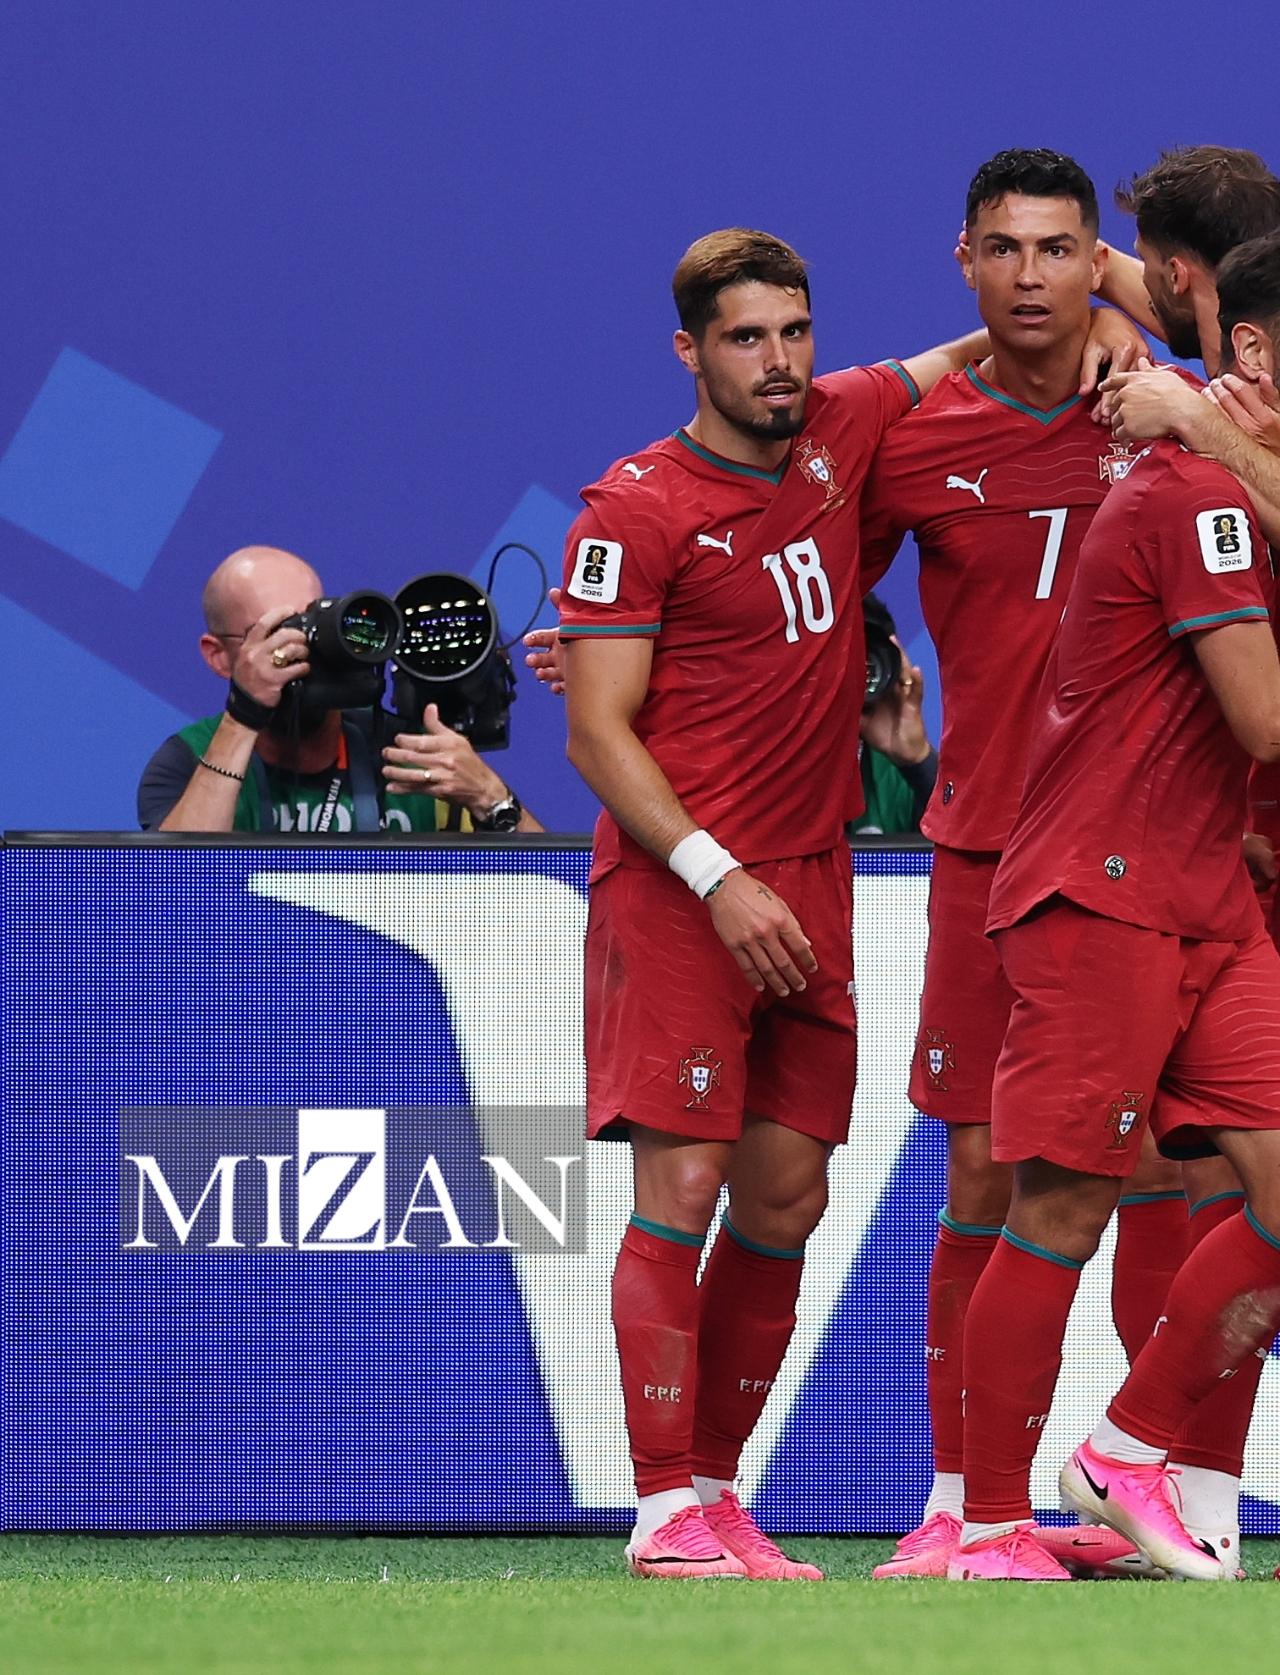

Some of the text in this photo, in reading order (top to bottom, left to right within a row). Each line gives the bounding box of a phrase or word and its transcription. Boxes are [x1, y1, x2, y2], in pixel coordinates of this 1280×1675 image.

[1029, 507, 1068, 600] 7
[1218, 558, 1242, 567] 2026
[581, 588, 603, 597] 2026
[761, 536, 834, 643] 18
[327, 778, 342, 803] FIFA
